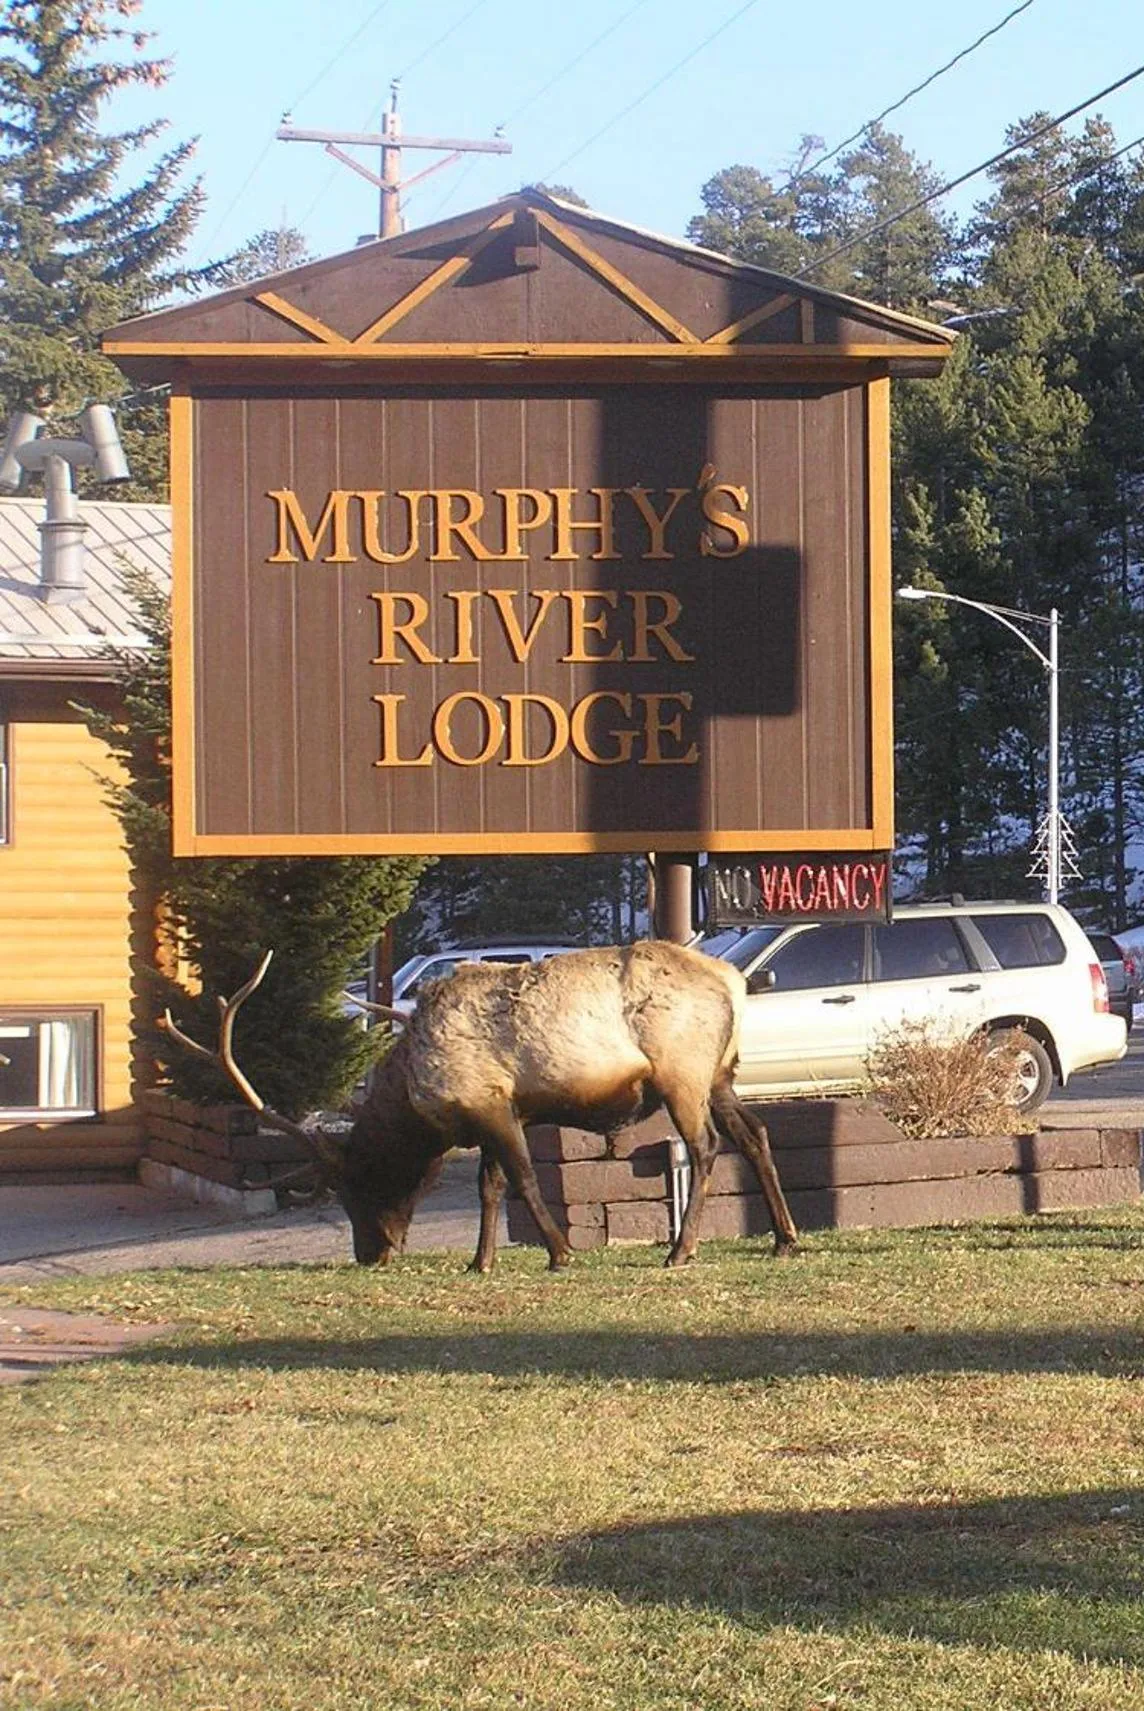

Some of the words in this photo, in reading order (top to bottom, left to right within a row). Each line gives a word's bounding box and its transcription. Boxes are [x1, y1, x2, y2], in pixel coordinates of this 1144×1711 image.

[266, 464, 751, 564] MURPHY'S
[371, 588, 696, 666] RIVER
[372, 690, 700, 768] LODGE
[714, 865, 752, 909] NO
[759, 863, 887, 912] VACANCY
